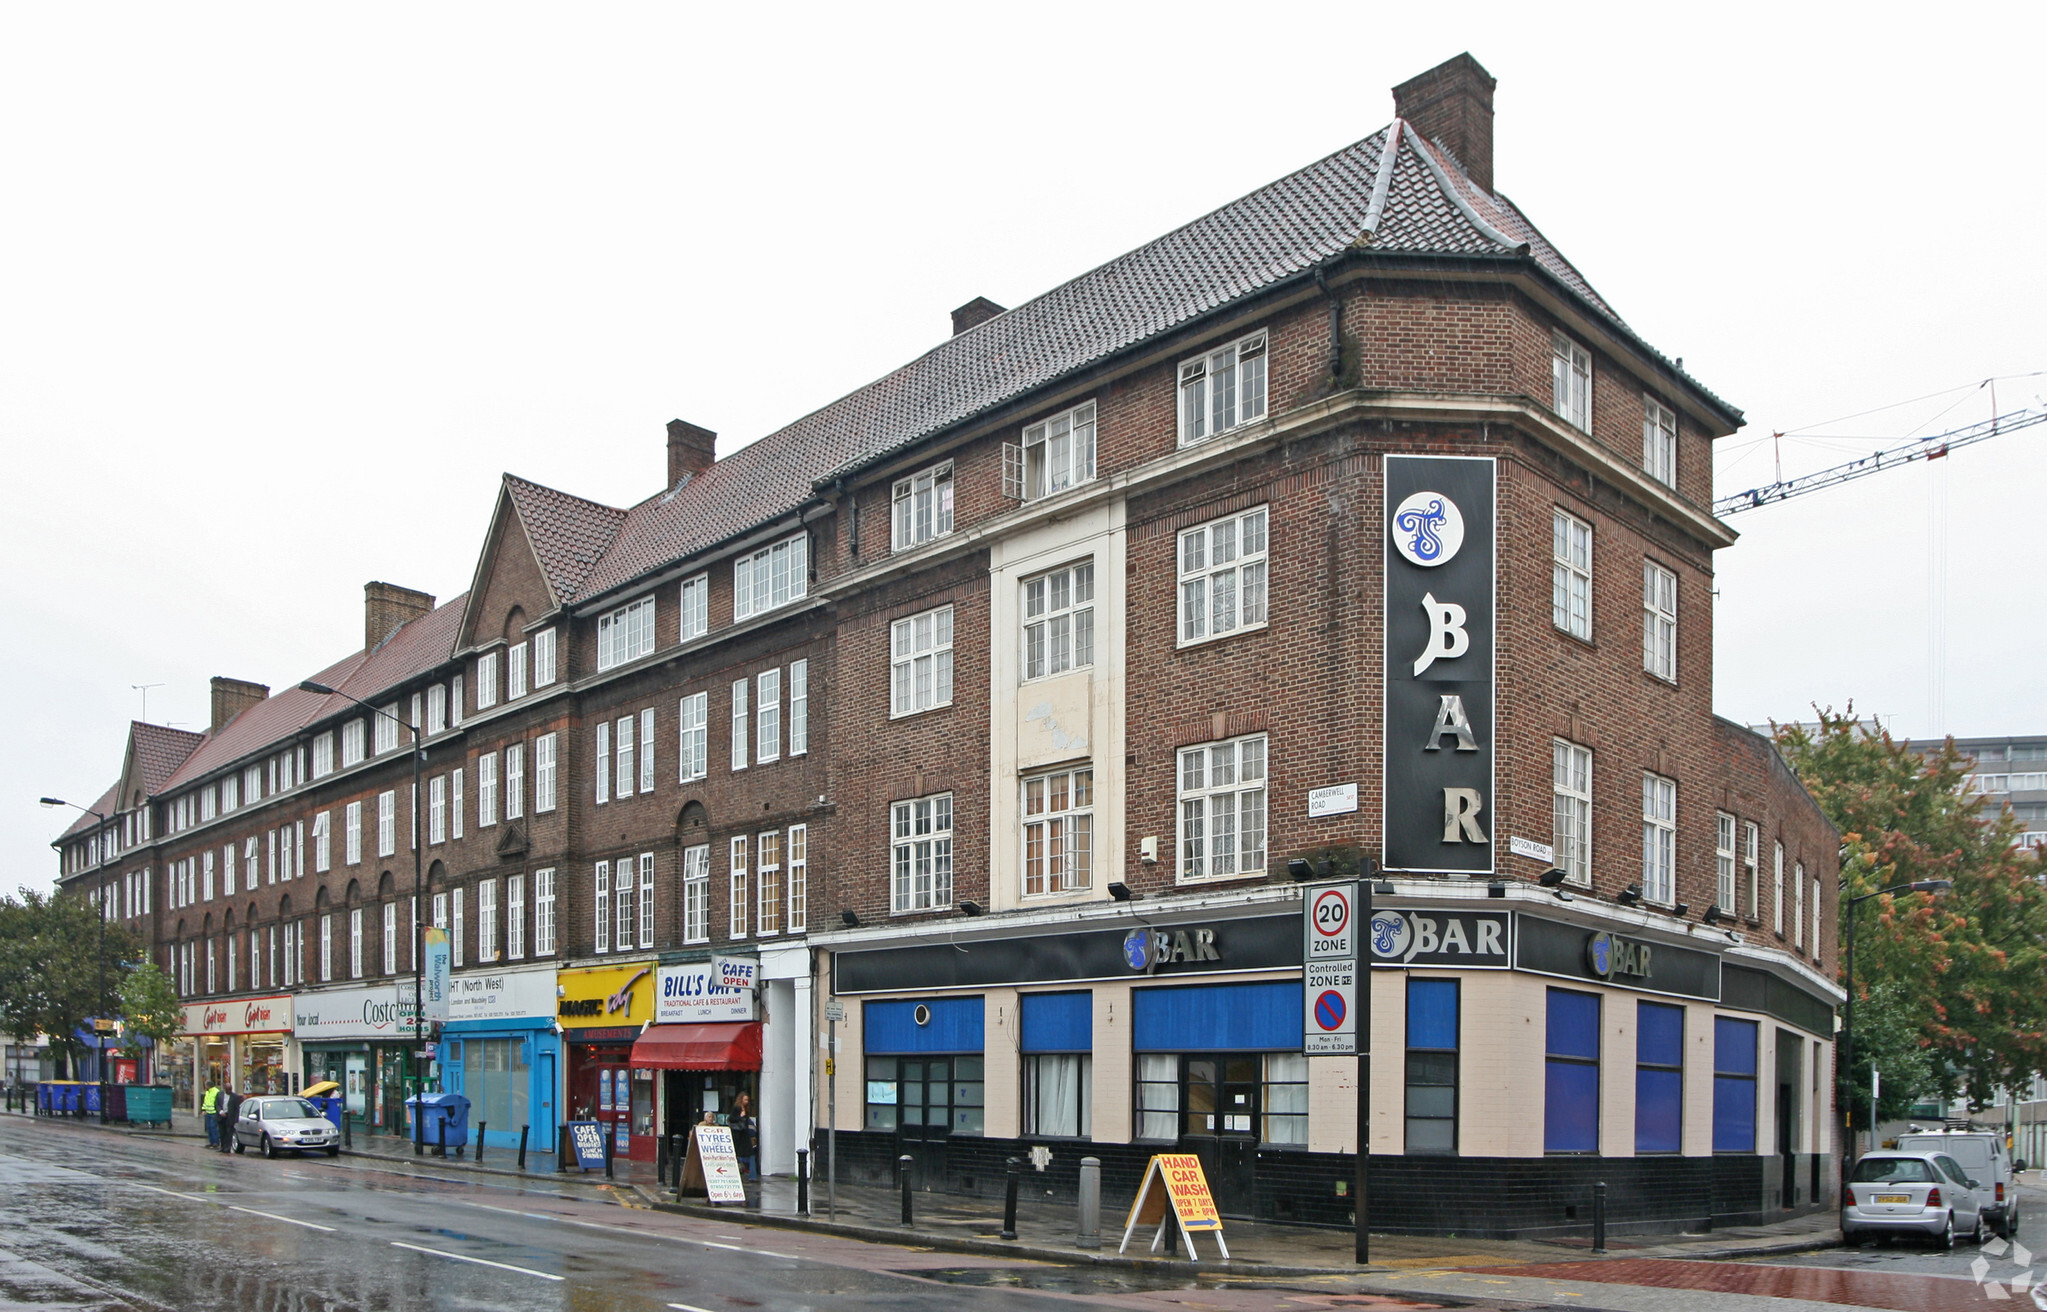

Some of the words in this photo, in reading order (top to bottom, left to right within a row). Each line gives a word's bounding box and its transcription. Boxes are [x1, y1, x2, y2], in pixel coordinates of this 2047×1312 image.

[1311, 787, 1344, 799] CAMBERWELL
[1311, 801, 1326, 809] ROAD
[1511, 838, 1531, 850] BOYSON
[1533, 844, 1546, 854] ROAD
[1319, 904, 1343, 923] 20
[1404, 912, 1505, 962] BAR
[1148, 928, 1220, 971] BAR
[1314, 939, 1346, 951] ZONE
[1610, 936, 1652, 978] BAR
[722, 963, 753, 977] CAFE
[1309, 963, 1352, 973] Controlled
[462, 979, 482, 995] (North
[485, 976, 504, 992] West)
[664, 975, 704, 997] BILL'S
[723, 977, 748, 986] OPEN
[1309, 976, 1340, 987] ZONE
[1342, 976, 1352, 985] M2
[710, 997, 741, 1005] RESTAURANT
[559, 999, 603, 1016] MAGIC
[584, 1028, 632, 1039] AMUSEMENTS
[574, 1125, 596, 1134] CAFE
[577, 1134, 600, 1142] OPEN
[698, 1134, 731, 1143] TYRES
[701, 1146, 733, 1154] WHEELS
[1162, 1157, 1198, 1169] HAND
[1172, 1170, 1199, 1182] CAR
[1171, 1184, 1208, 1196] WASH
[1176, 1199, 1192, 1207] OPEN
[1199, 1198, 1212, 1206] DAYS
[1179, 1208, 1194, 1217] 8AM
[1202, 1208, 1216, 1216] 8PM
